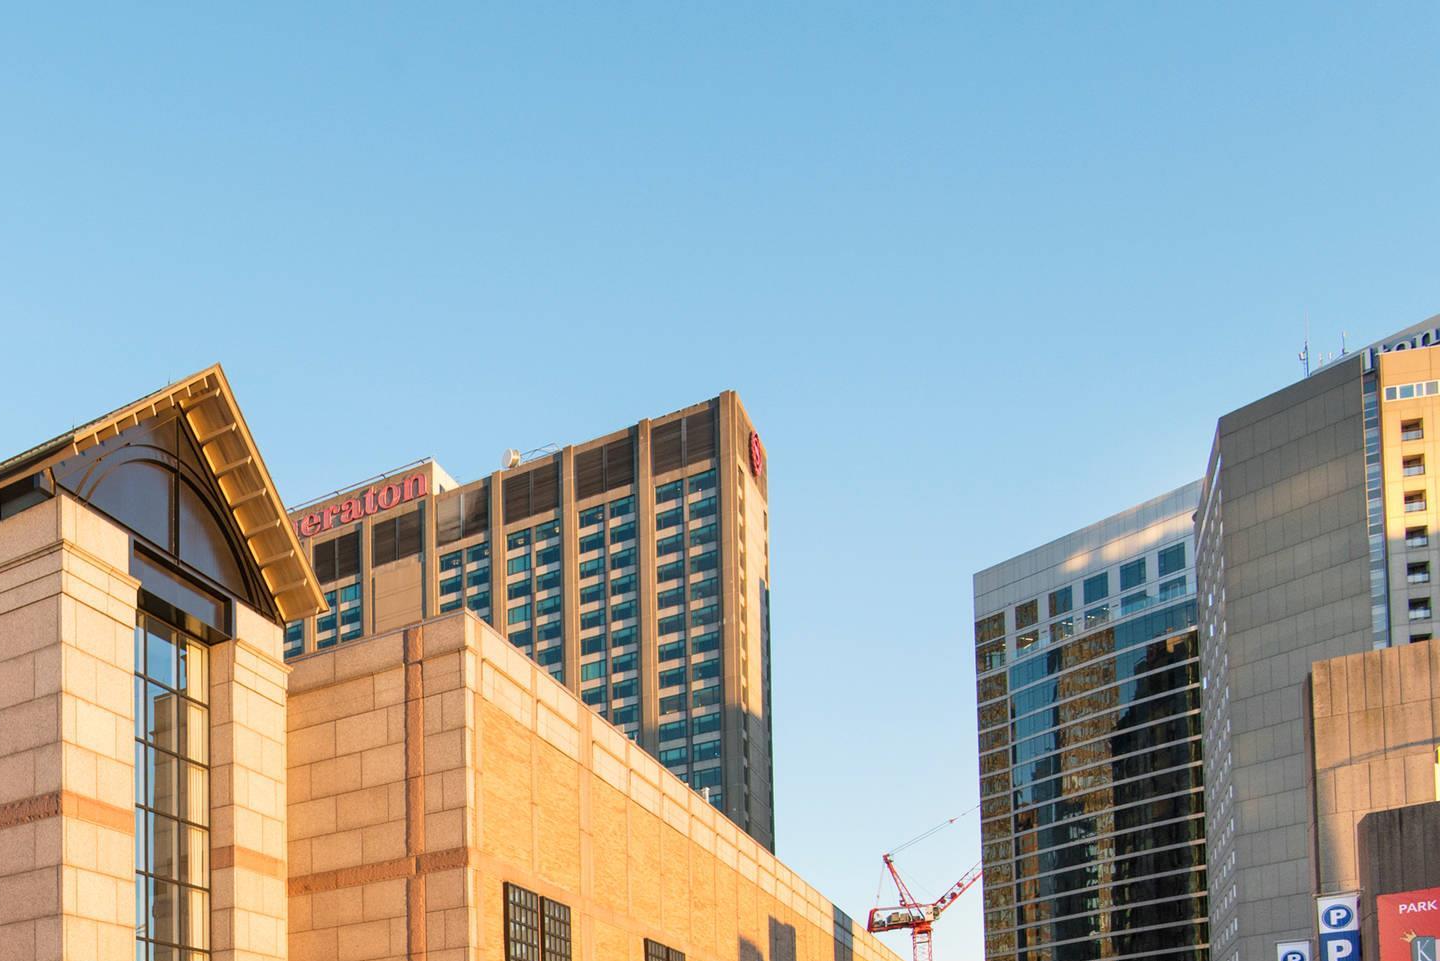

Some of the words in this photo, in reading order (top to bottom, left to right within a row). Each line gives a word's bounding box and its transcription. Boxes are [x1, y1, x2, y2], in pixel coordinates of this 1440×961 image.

[293, 471, 428, 538] eraton
[1398, 900, 1438, 915] PARK
[1329, 908, 1347, 926] P
